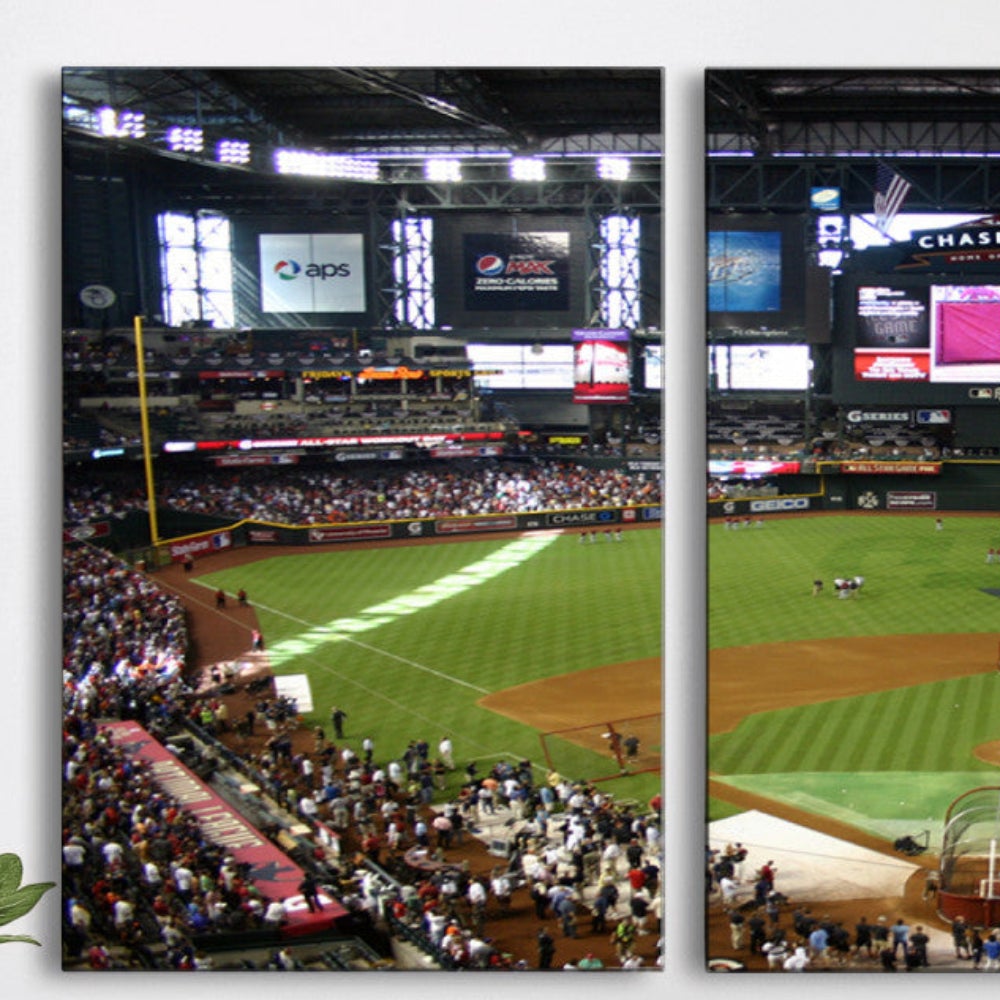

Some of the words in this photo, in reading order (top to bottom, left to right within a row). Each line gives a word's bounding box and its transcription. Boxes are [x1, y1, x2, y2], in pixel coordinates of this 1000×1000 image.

[305, 263, 351, 280] aps
[751, 499, 808, 510] GEICO
[552, 511, 598, 523] CHASE
